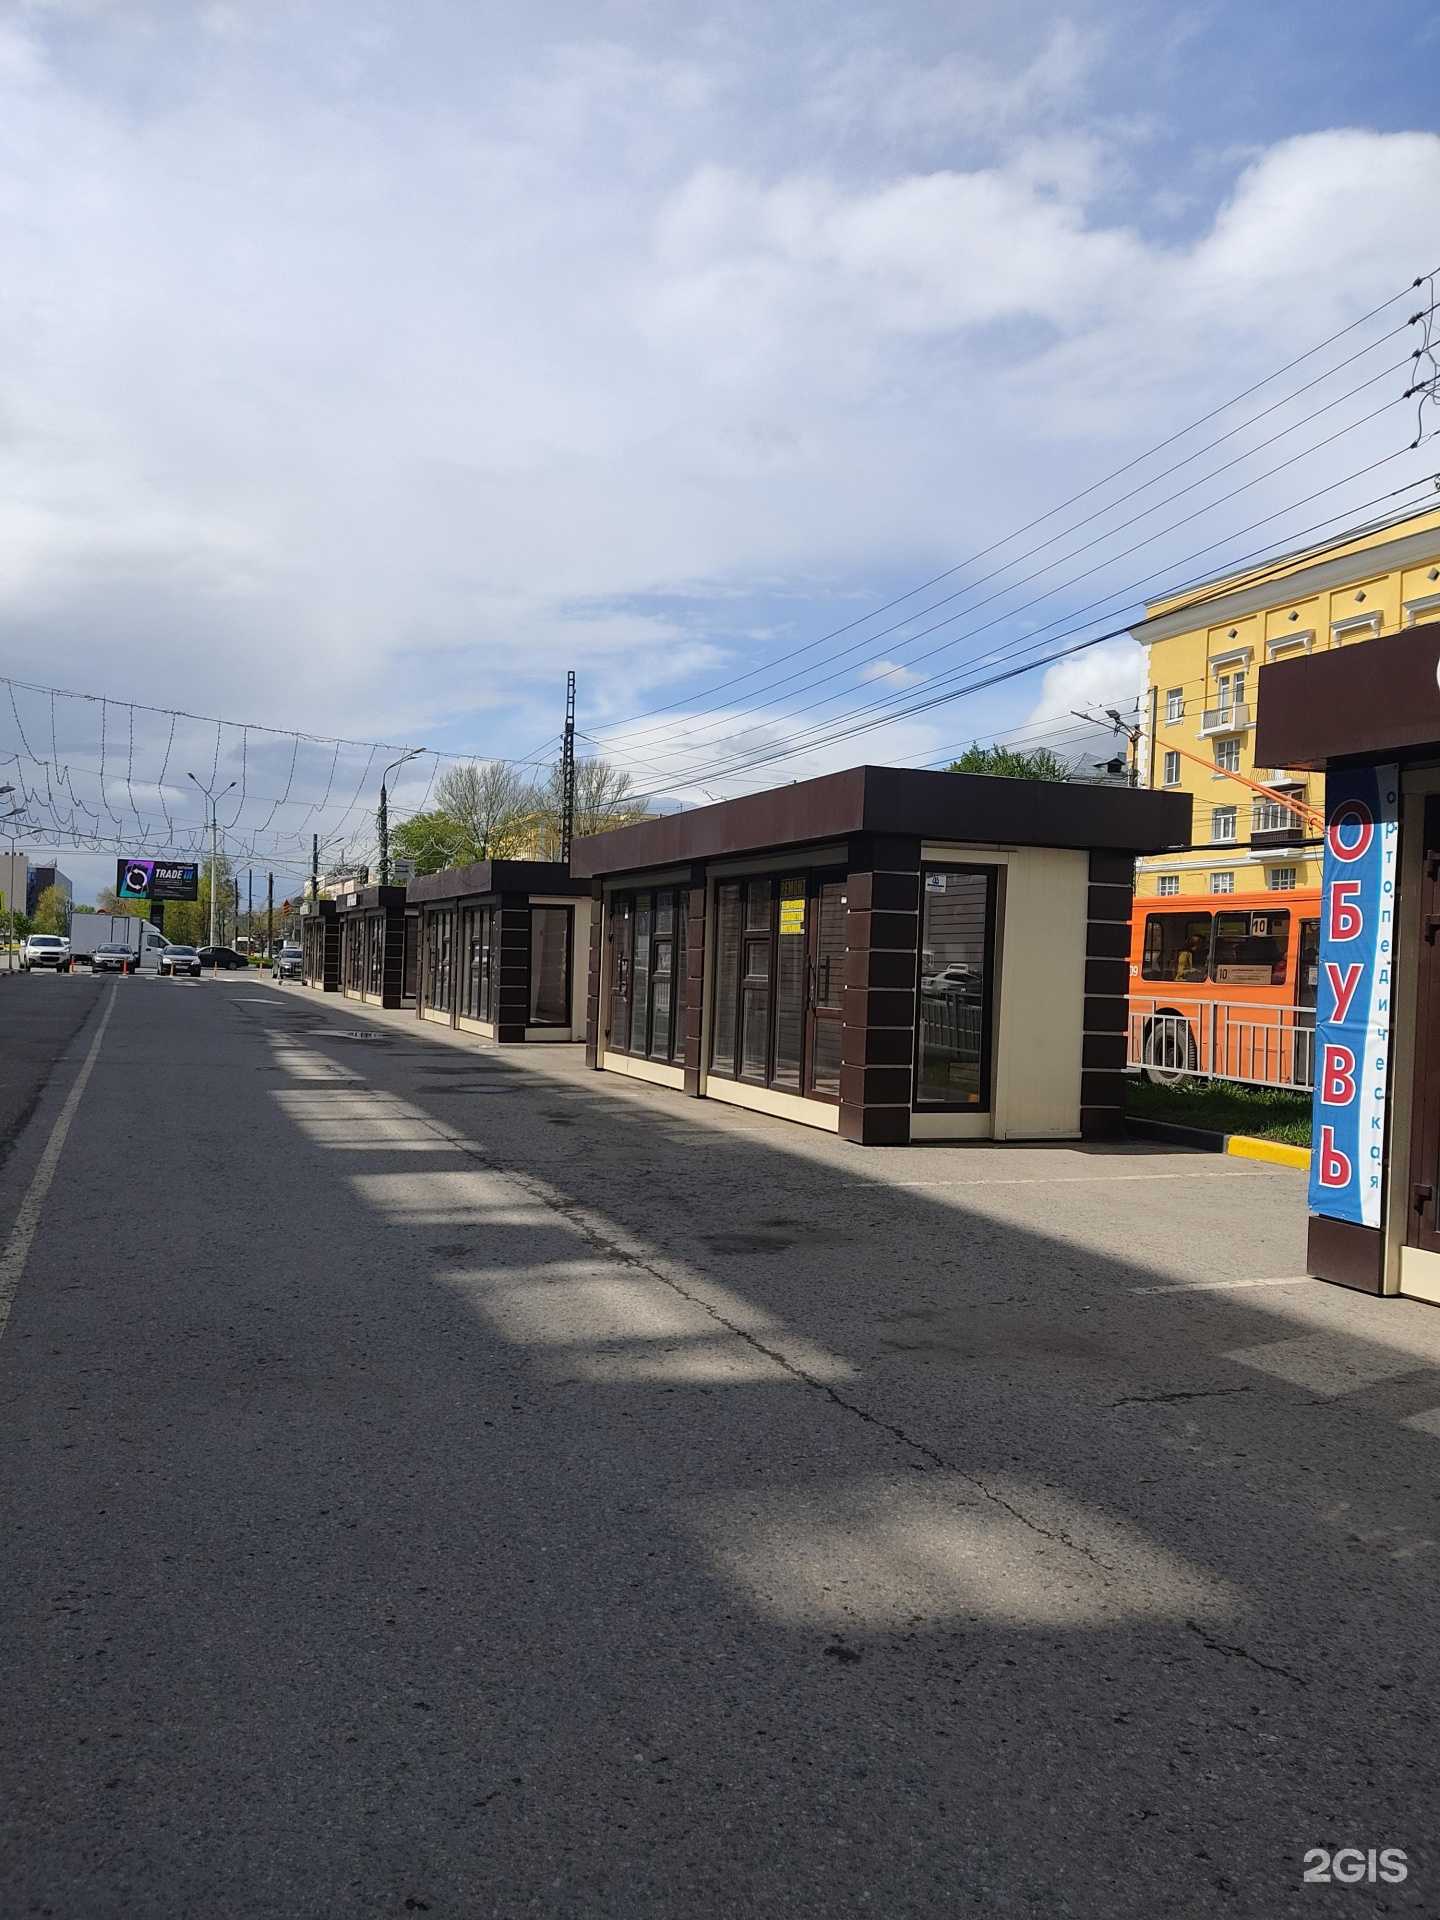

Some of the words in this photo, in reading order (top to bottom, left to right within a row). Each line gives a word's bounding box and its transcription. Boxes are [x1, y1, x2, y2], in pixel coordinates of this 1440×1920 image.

[155, 868, 183, 879] TRADE
[1253, 919, 1266, 933] 10
[1319, 799, 1374, 1188] ОБУВЬ
[1369, 791, 1398, 1188] ортопедическая
